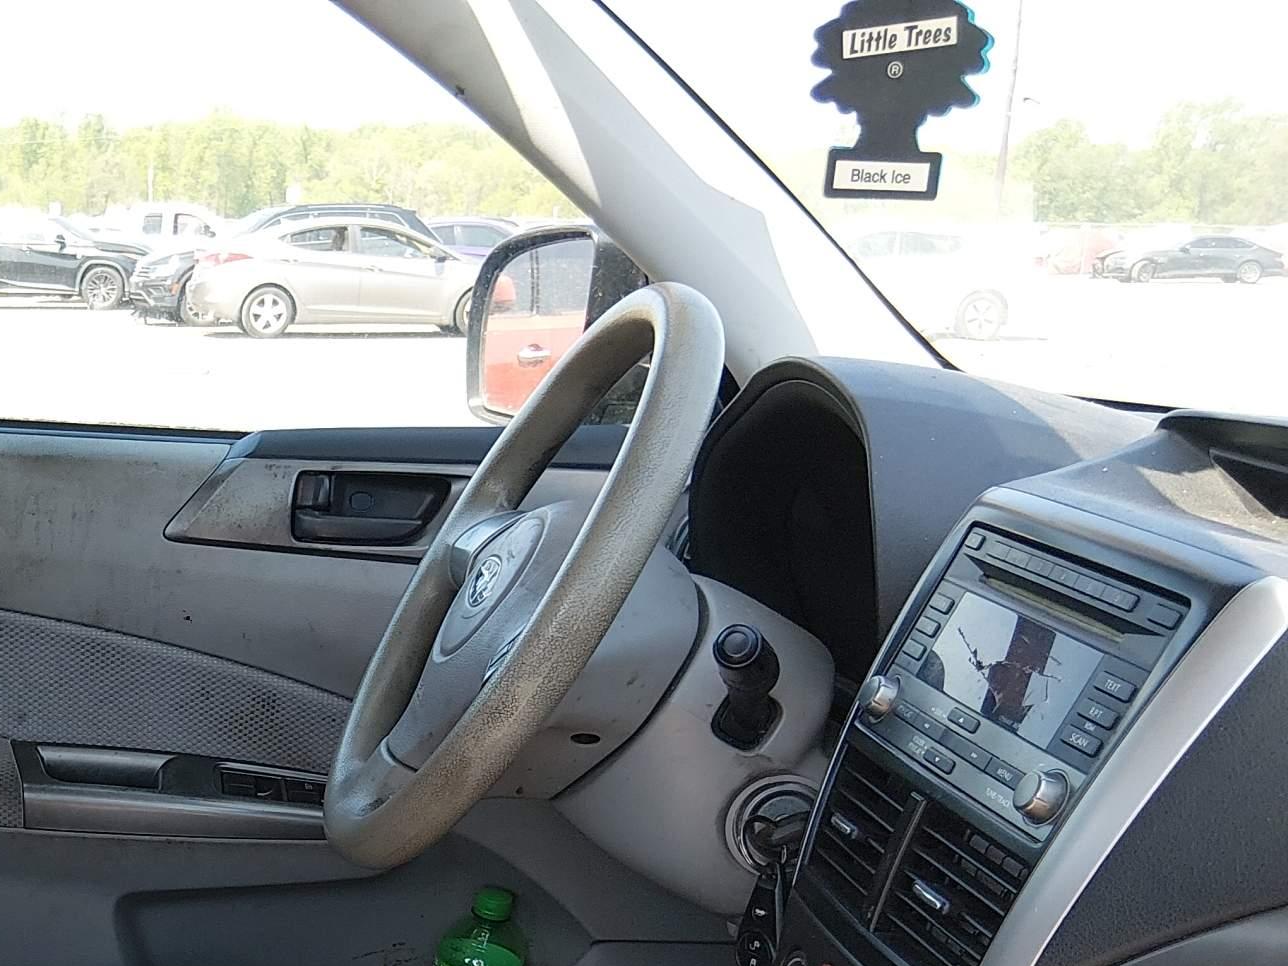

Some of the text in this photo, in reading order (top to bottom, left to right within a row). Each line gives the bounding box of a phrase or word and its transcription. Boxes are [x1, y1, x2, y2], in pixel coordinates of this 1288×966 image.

[849, 25, 952, 55] Little Trees
[850, 168, 911, 184] Black Ice
[1069, 732, 1089, 747] SCAN
